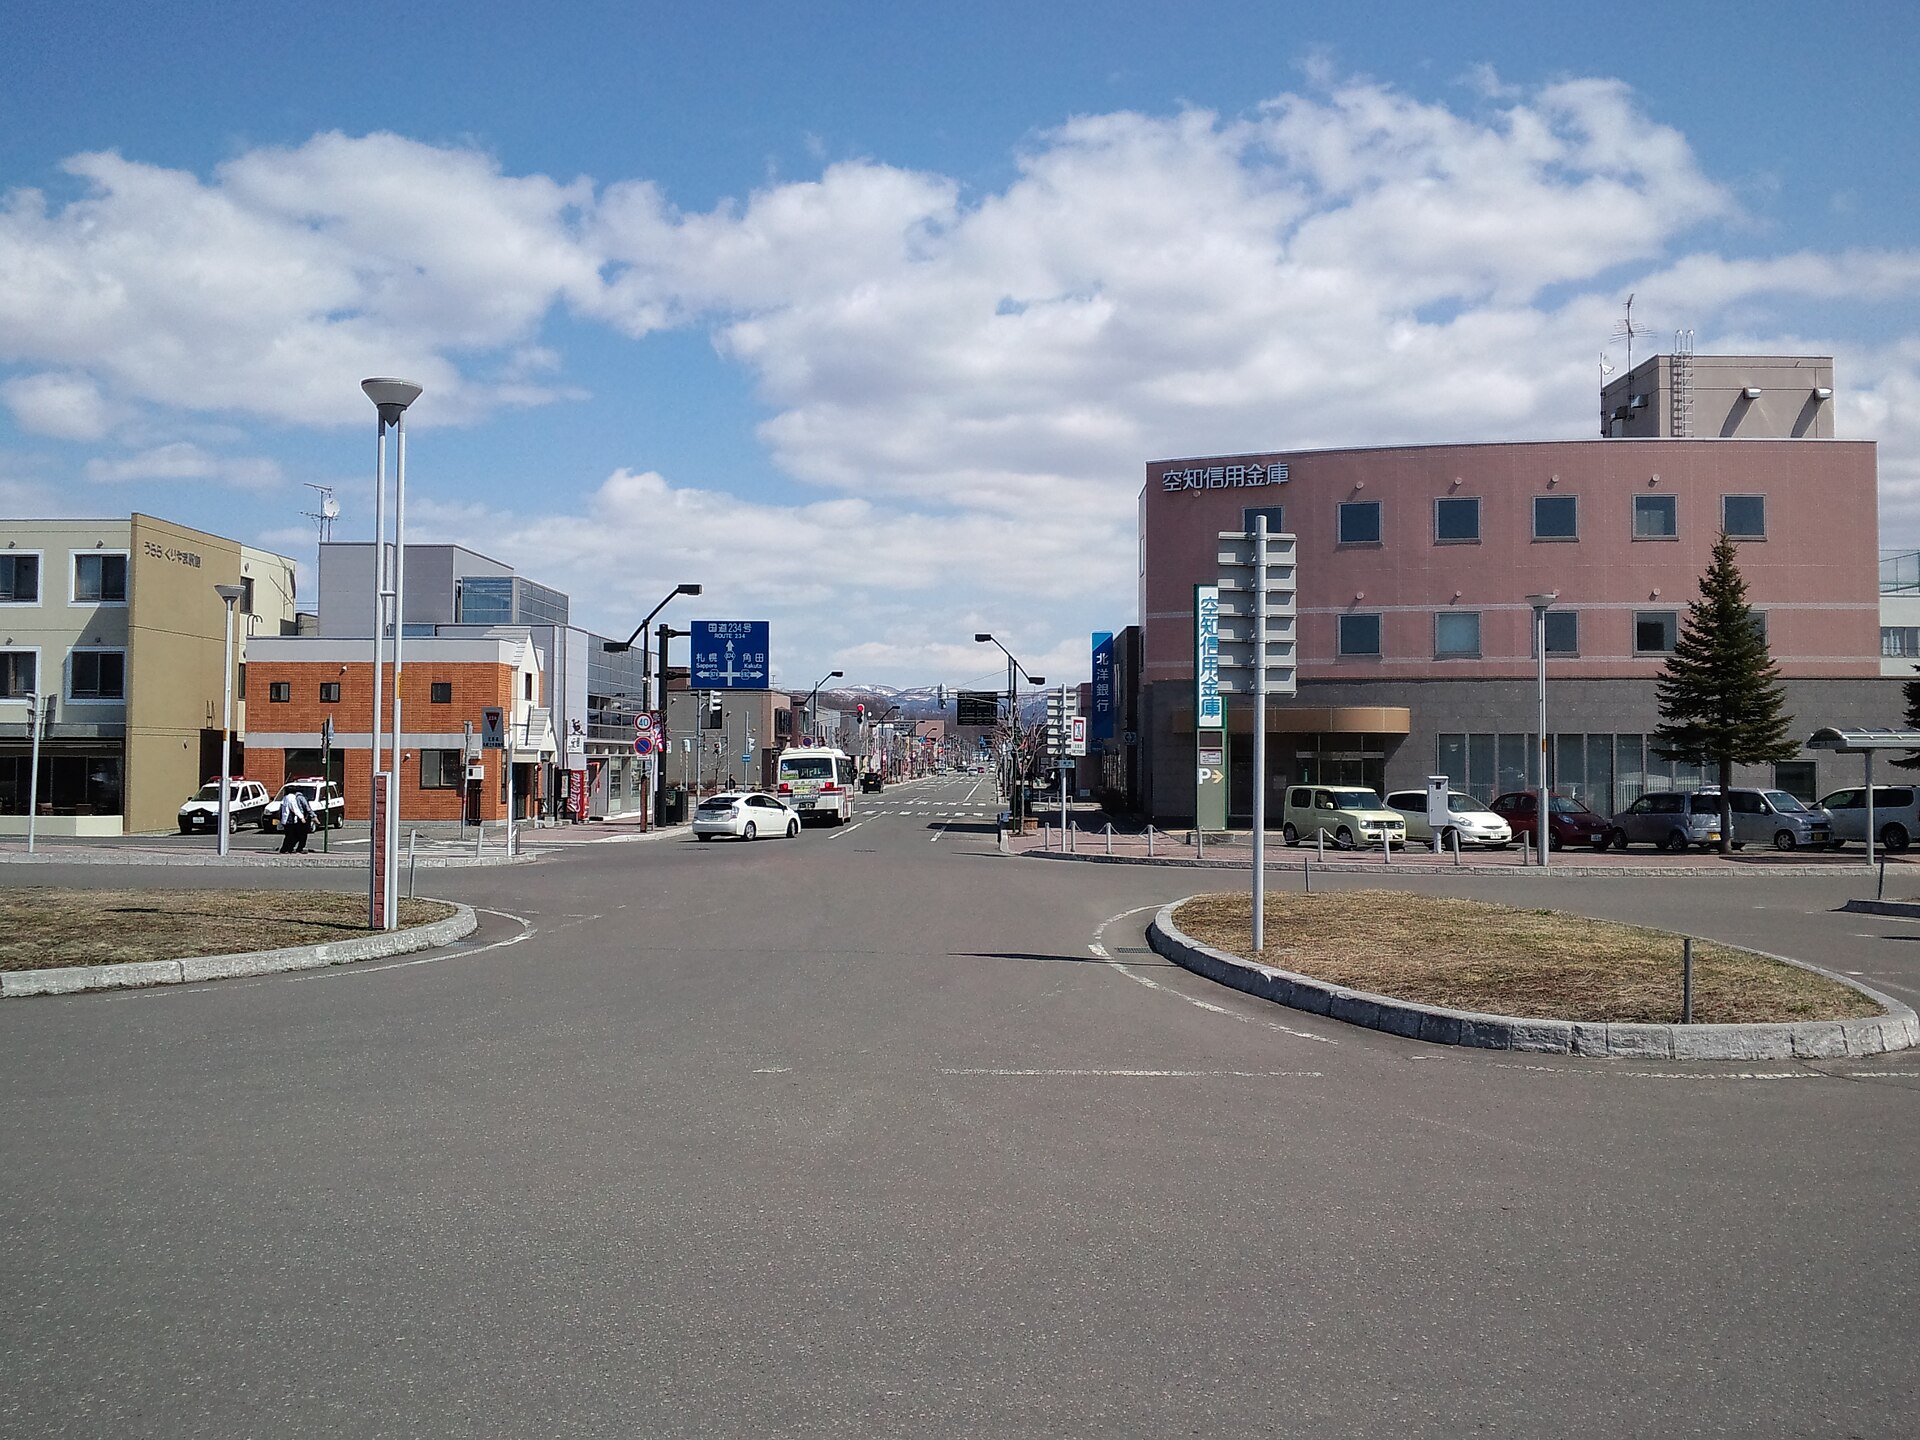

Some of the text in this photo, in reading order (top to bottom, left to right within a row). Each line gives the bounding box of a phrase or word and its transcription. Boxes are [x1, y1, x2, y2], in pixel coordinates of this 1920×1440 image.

[1162, 462, 1289, 491] 空知信用金庫
[708, 623, 752, 632] 国道234号
[696, 652, 718, 662] 札幌
[742, 652, 764, 662] 角田
[1200, 596, 1220, 718] 空知信用金庫
[1096, 652, 1109, 712] 北洋銀行
[638, 718, 649, 727] 40
[1199, 768, 1212, 785] P
